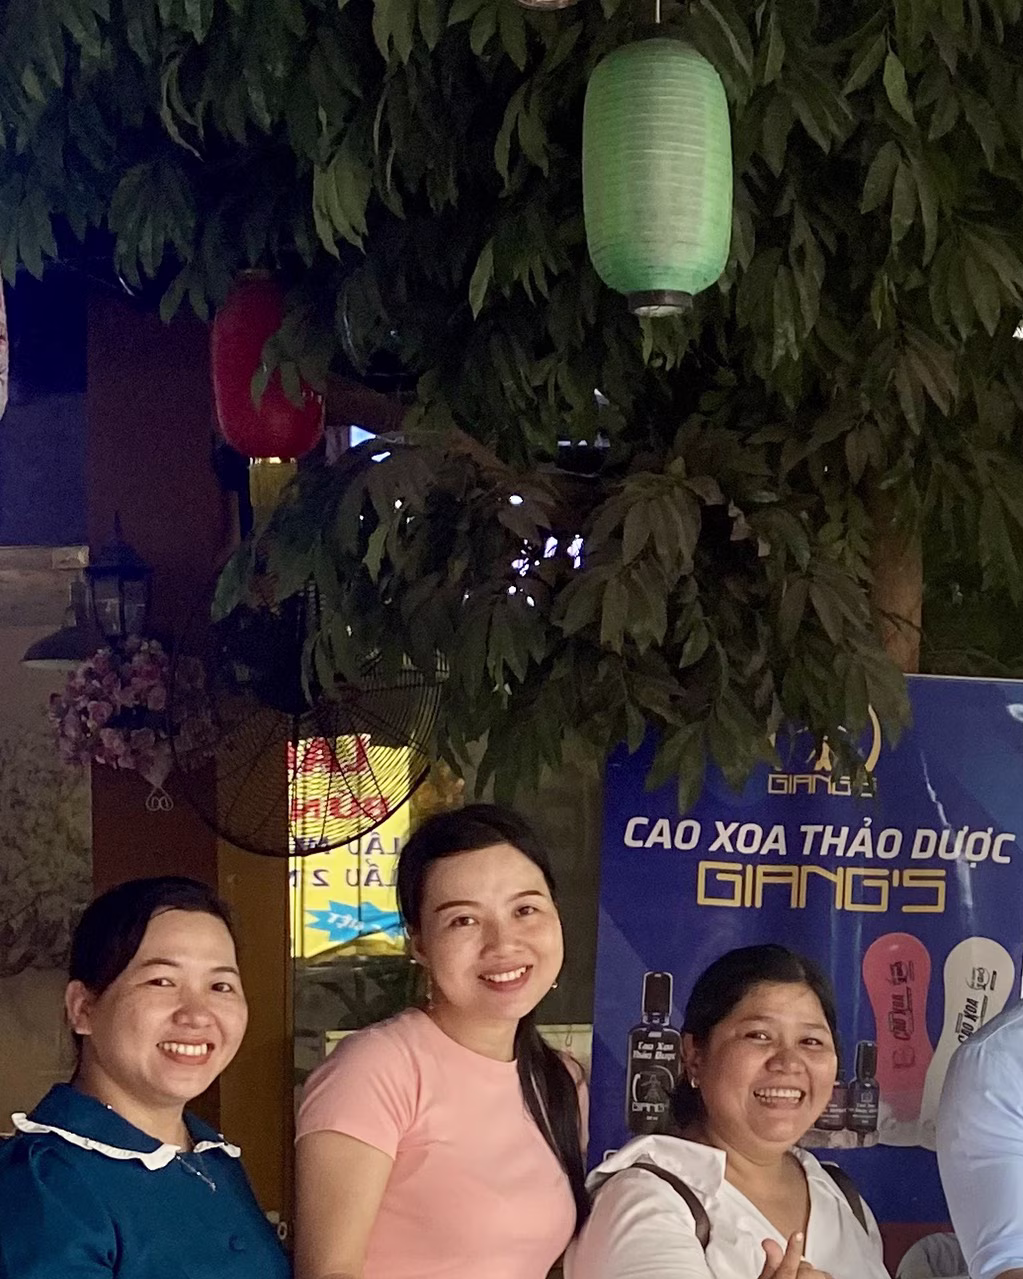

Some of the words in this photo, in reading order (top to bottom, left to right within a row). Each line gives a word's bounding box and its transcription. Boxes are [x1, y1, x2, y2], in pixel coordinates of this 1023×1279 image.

[623, 817, 702, 850] CAO
[709, 821, 788, 856] XOA
[800, 817, 903, 859] THẢO
[911, 826, 1016, 867] DƯỢC
[697, 861, 946, 913] GIANG'S
